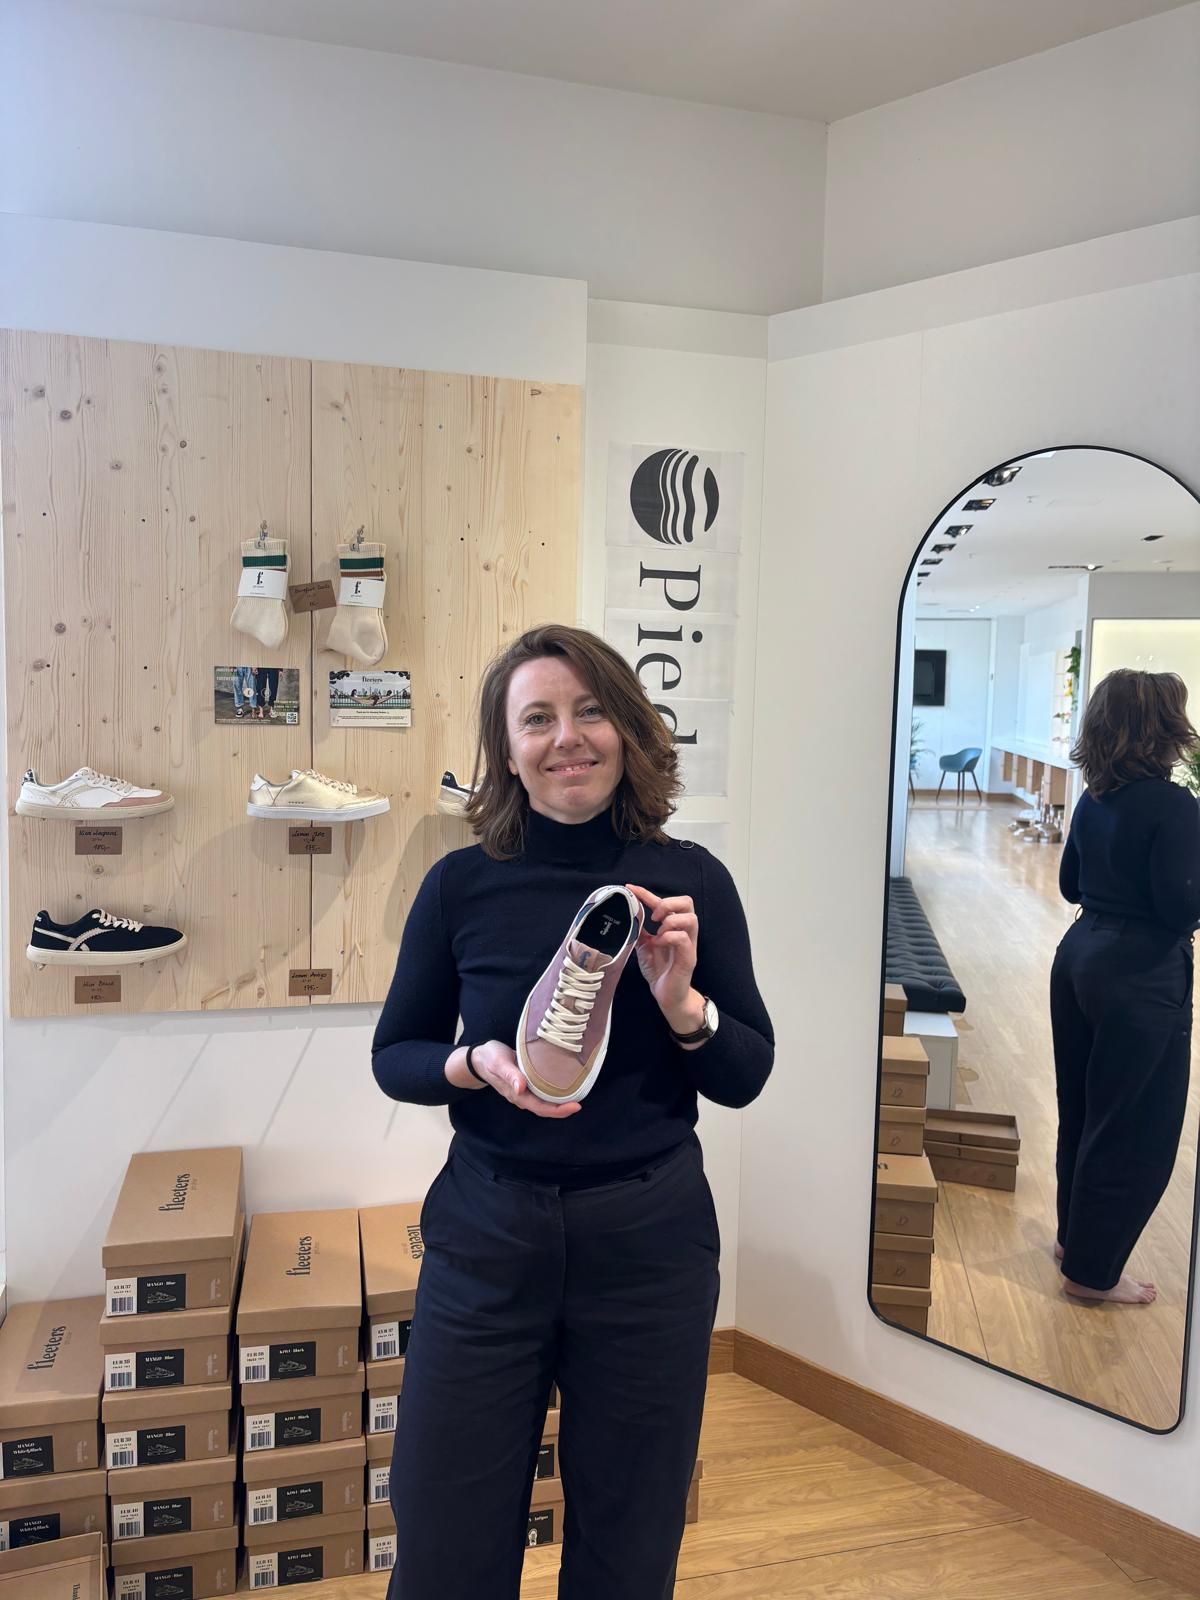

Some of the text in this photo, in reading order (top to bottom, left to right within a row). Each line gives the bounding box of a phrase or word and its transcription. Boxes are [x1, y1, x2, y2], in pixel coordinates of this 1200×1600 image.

[256, 570, 264, 584] f.
[354, 580, 362, 594] f.
[158, 1172, 191, 1212] fleeters
[286, 1235, 313, 1277] fleeters
[27, 1325, 67, 1372] fleeters
